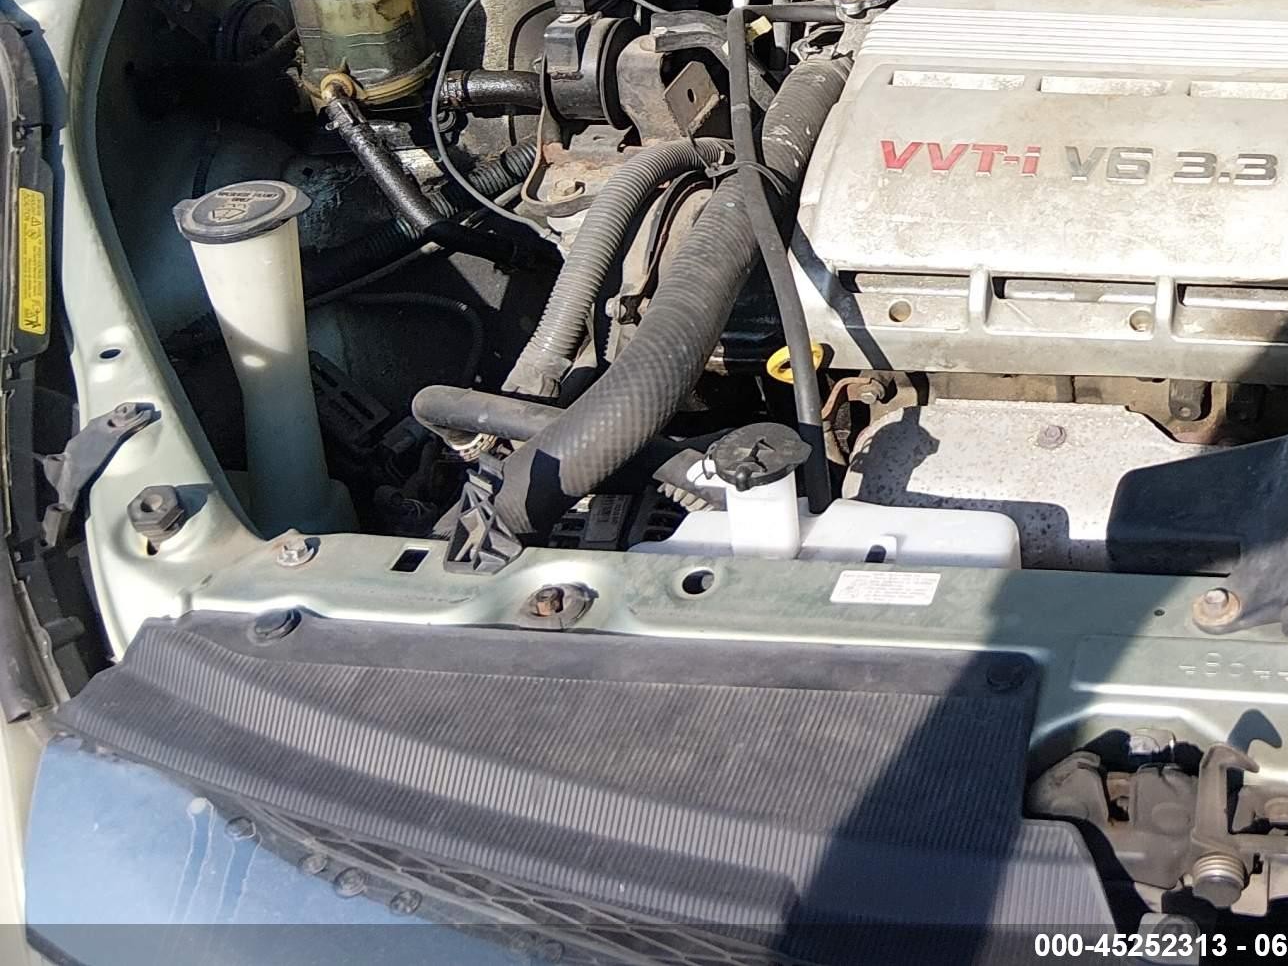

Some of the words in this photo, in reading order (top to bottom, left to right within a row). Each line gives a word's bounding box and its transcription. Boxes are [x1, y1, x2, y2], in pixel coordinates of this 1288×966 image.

[880, 139, 1041, 179] VVT-i
[1065, 146, 1154, 184] V6
[1172, 151, 1279, 186] 3.3
